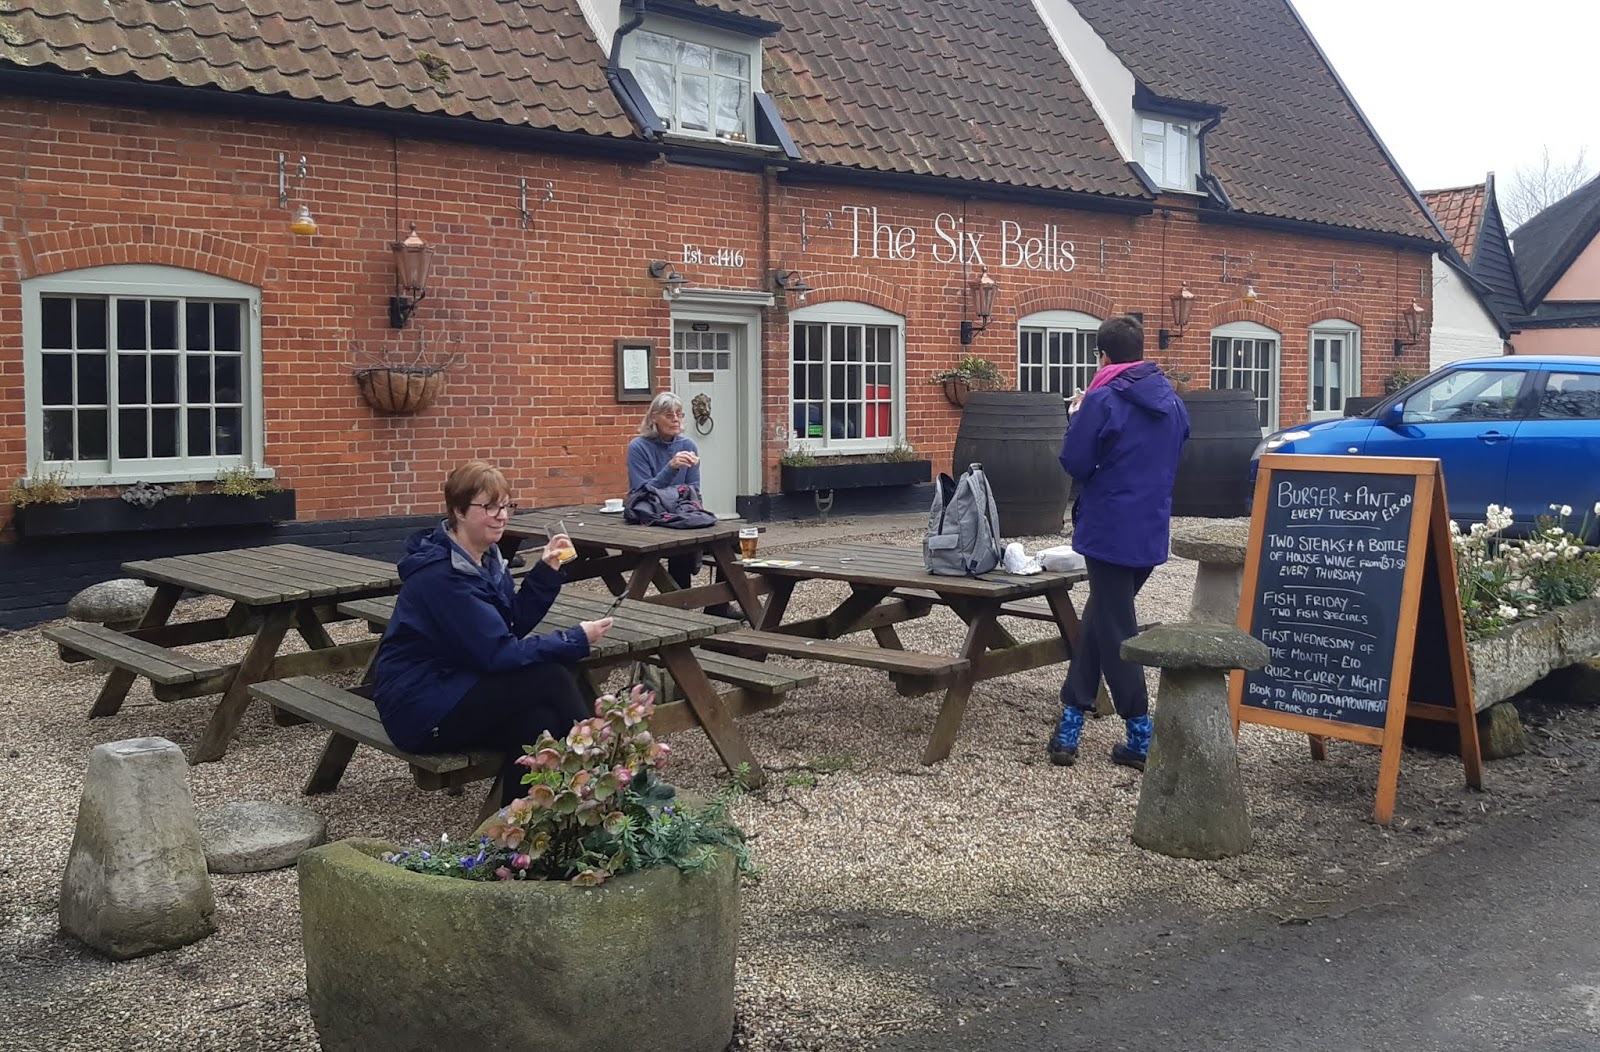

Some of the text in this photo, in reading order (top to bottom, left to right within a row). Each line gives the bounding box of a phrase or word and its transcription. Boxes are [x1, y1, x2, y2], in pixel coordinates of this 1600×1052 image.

[841, 205, 1076, 272] The Six Bells
[683, 243, 703, 264] Est
[1277, 481, 1340, 508] BURGER
[1356, 485, 1396, 508] PINT
[1290, 508, 1324, 521] EVERY
[1328, 509, 1378, 522] TUESDAY
[1268, 534, 1294, 548] TWO
[1356, 540, 1365, 552] A
[1369, 538, 1406, 553] BOTTLE
[1269, 551, 1283, 561] OF
[1286, 552, 1320, 564] HOUSE
[1324, 555, 1356, 568] WINE
[1279, 565, 1363, 585] EVERY THURSDAY
[1263, 591, 1296, 607] FISH
[1304, 594, 1349, 611] FRIDAY
[1269, 607, 1368, 625] TWO FISH SPECIALS
[1261, 628, 1375, 655] FIRST WEDNESDAY OF
[1268, 646, 1287, 659] THE
[1291, 648, 1328, 667] MONTH
[1341, 655, 1362, 669] £10
[1264, 664, 1292, 679] QUIZ
[1303, 669, 1345, 690] CURRY
[1351, 674, 1388, 693] NIGHT
[1249, 682, 1388, 713] BOOK TO AVOID DISAPPOINTMENT
[1273, 700, 1303, 714] TEAMS
[1306, 707, 1319, 717] OF
